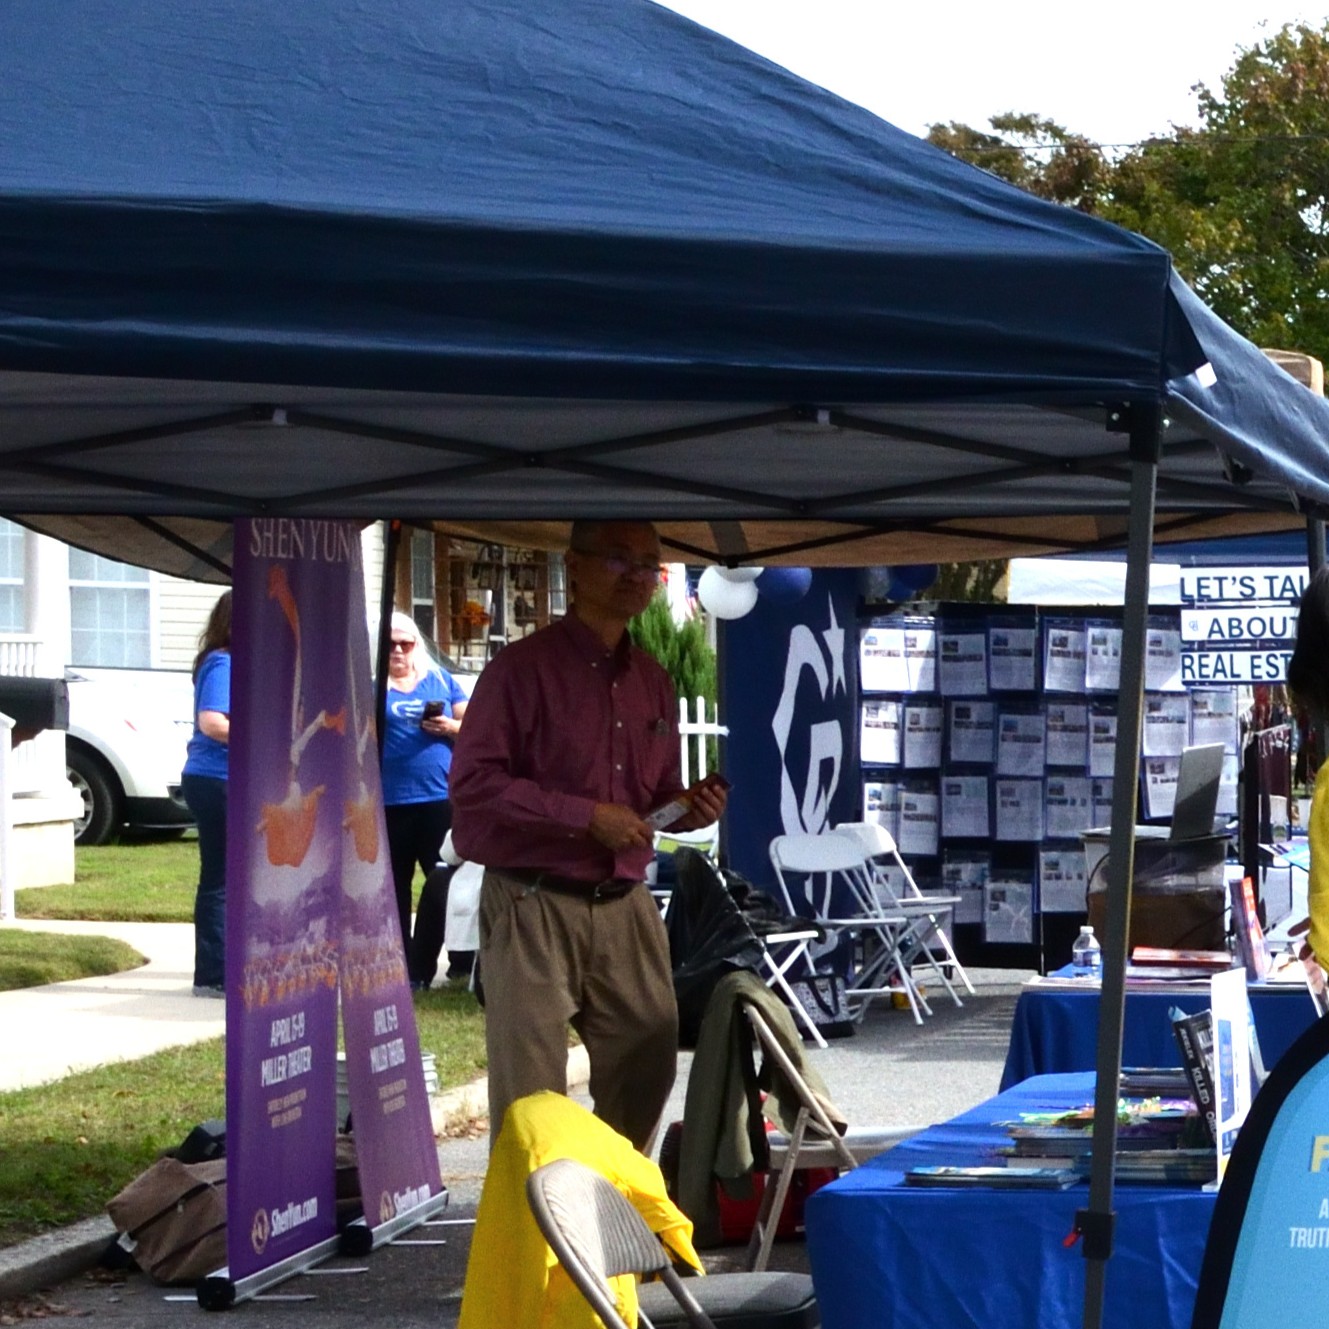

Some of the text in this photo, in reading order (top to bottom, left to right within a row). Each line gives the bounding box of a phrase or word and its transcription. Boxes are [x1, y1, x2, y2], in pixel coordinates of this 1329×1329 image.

[250, 517, 305, 559] SHEN
[1180, 574, 1309, 600] LET'S TAL
[1181, 653, 1293, 680] REAL EST
[261, 1054, 288, 1088] MILLER
[1191, 1066, 1210, 1105] KILLED
[271, 1196, 318, 1238] ShenYun.com
[1318, 1198, 1329, 1219] A
